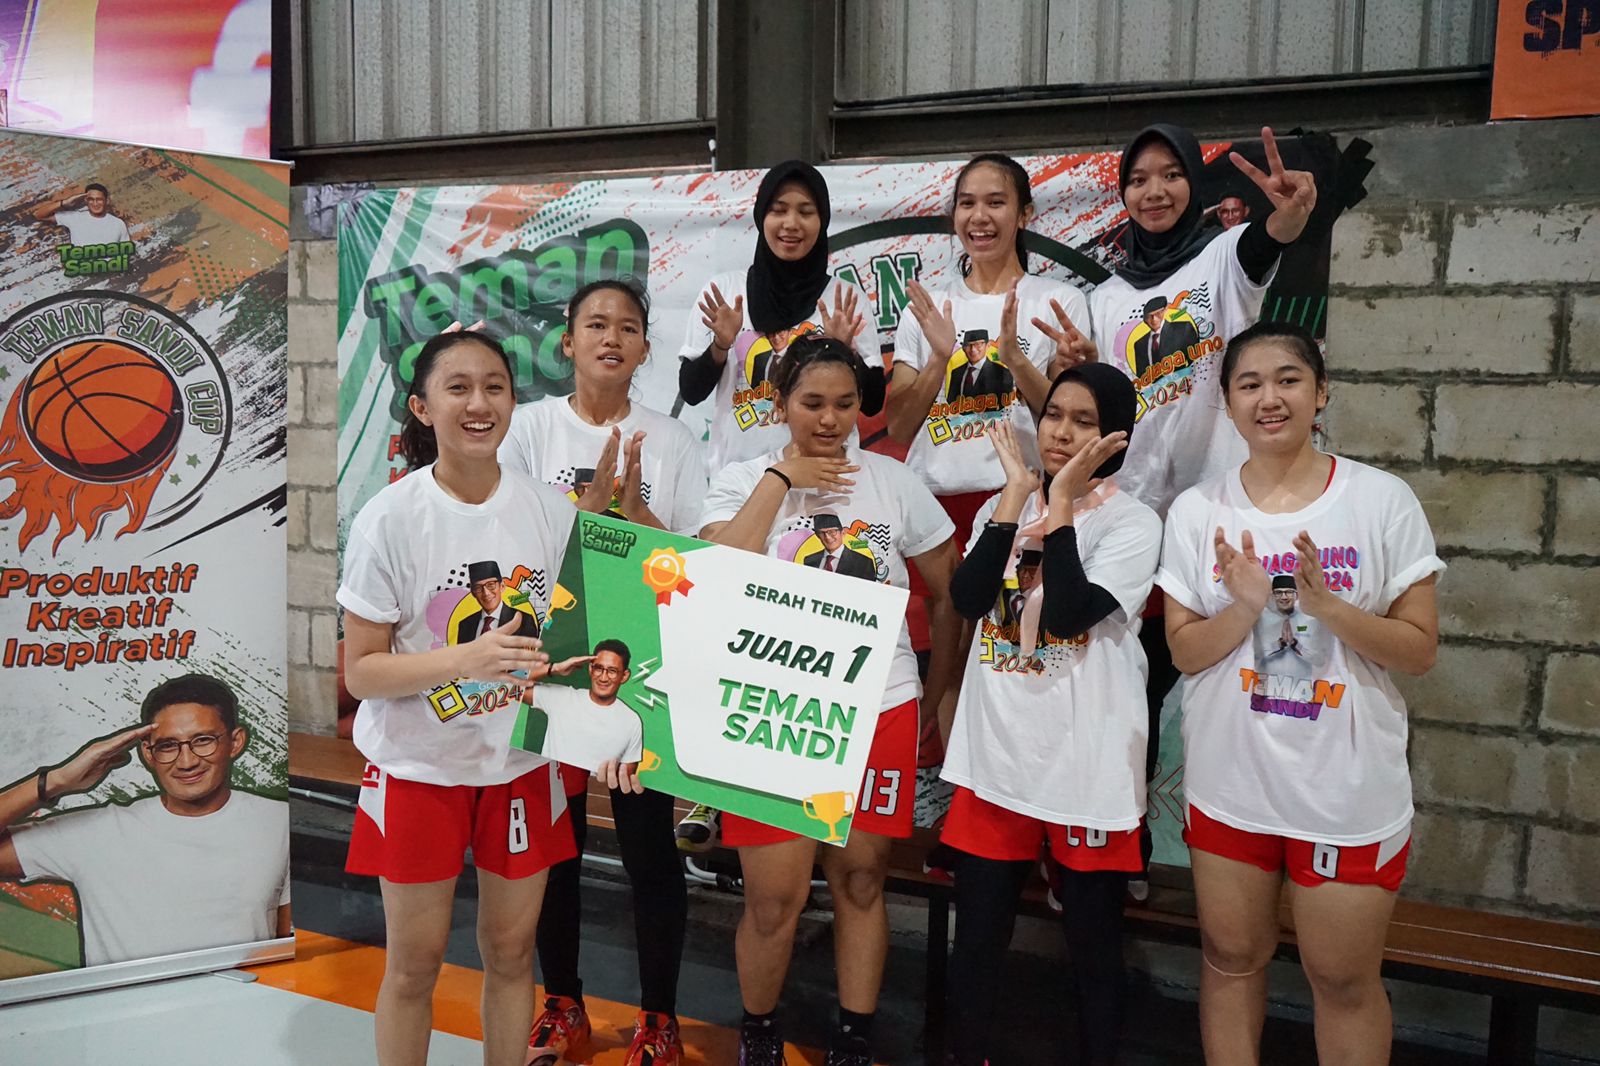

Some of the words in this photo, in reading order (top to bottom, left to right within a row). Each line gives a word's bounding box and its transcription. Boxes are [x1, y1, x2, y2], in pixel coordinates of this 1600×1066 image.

[56, 241, 134, 260] Teman
[65, 254, 129, 276] Sandi
[368, 224, 640, 348] Teman
[1187, 335, 1223, 361] uno
[0, 303, 104, 363] TEMAN
[117, 308, 205, 377] SANDI
[184, 380, 225, 434] CUP
[1148, 376, 1193, 412] 2024
[583, 520, 637, 543] Teman
[583, 534, 630, 557] Sandi
[0, 562, 199, 598] Produktif
[27, 596, 174, 632] Kreatif
[744, 583, 806, 611] SERAH
[810, 598, 879, 630] TERIMA
[3, 629, 197, 671] Inspiratif
[727, 628, 835, 678] JUARA
[843, 645, 873, 684] 1
[992, 653, 1046, 676] 2024
[467, 684, 524, 716] 2024
[1239, 668, 1346, 708] TEMAN
[718, 678, 858, 735] TEMAN
[1250, 693, 1323, 721] SANDI
[721, 713, 850, 766] SANDI
[860, 767, 902, 816] 13
[508, 797, 530, 856] 8
